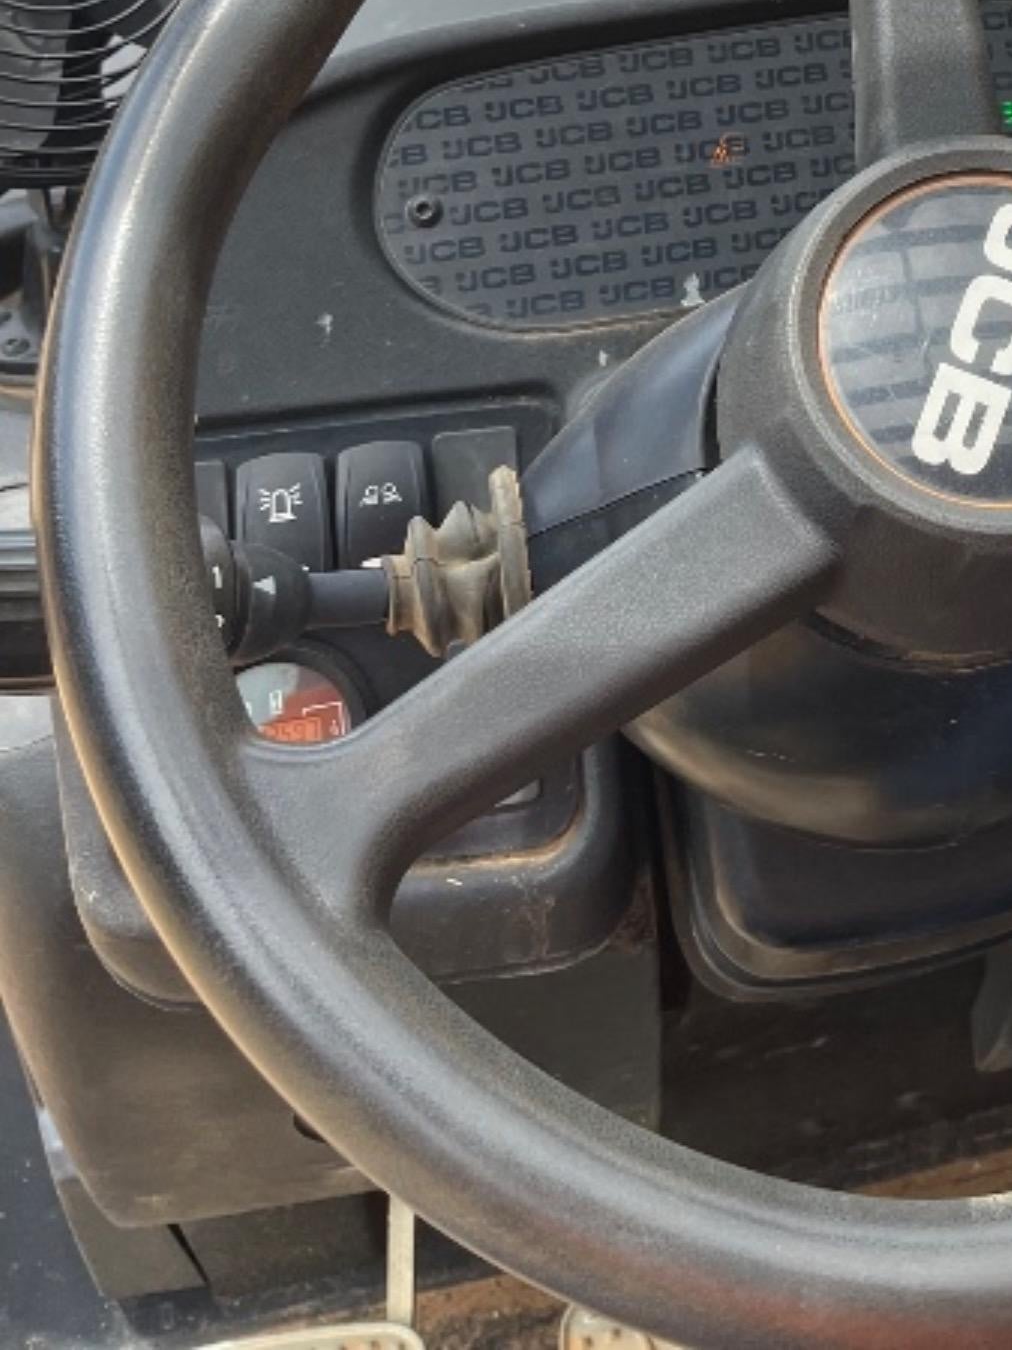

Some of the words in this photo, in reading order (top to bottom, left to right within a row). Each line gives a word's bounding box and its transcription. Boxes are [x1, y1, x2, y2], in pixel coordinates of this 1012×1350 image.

[617, 48, 694, 72] JCB
[707, 38, 781, 63] JCB
[794, 28, 851, 54] JC
[407, 105, 472, 131] CB
[485, 96, 564, 123] JCB
[575, 84, 654, 112] JCB
[665, 74, 742, 101] JCB
[754, 63, 829, 90] JCB
[442, 132, 522, 160] JCB
[535, 121, 614, 149] JCB
[625, 111, 703, 137] JCB
[715, 99, 790, 127] JCB
[801, 92, 854, 115] JC
[491, 158, 571, 187] JCB
[584, 148, 661, 175] JCB
[762, 126, 836, 153] JCB
[448, 197, 529, 227] JCB
[541, 186, 621, 214] JCB
[634, 173, 712, 202] JCB
[723, 161, 798, 189] JCB
[809, 153, 855, 178] JC
[499, 224, 579, 253] JCB
[591, 212, 670, 241] JCB
[682, 200, 758, 228] JCB
[454, 263, 537, 293] JCB
[548, 251, 628, 280] JCB
[640, 238, 718, 267] JCB
[505, 289, 587, 319] JCB
[597, 277, 677, 306] JCB
